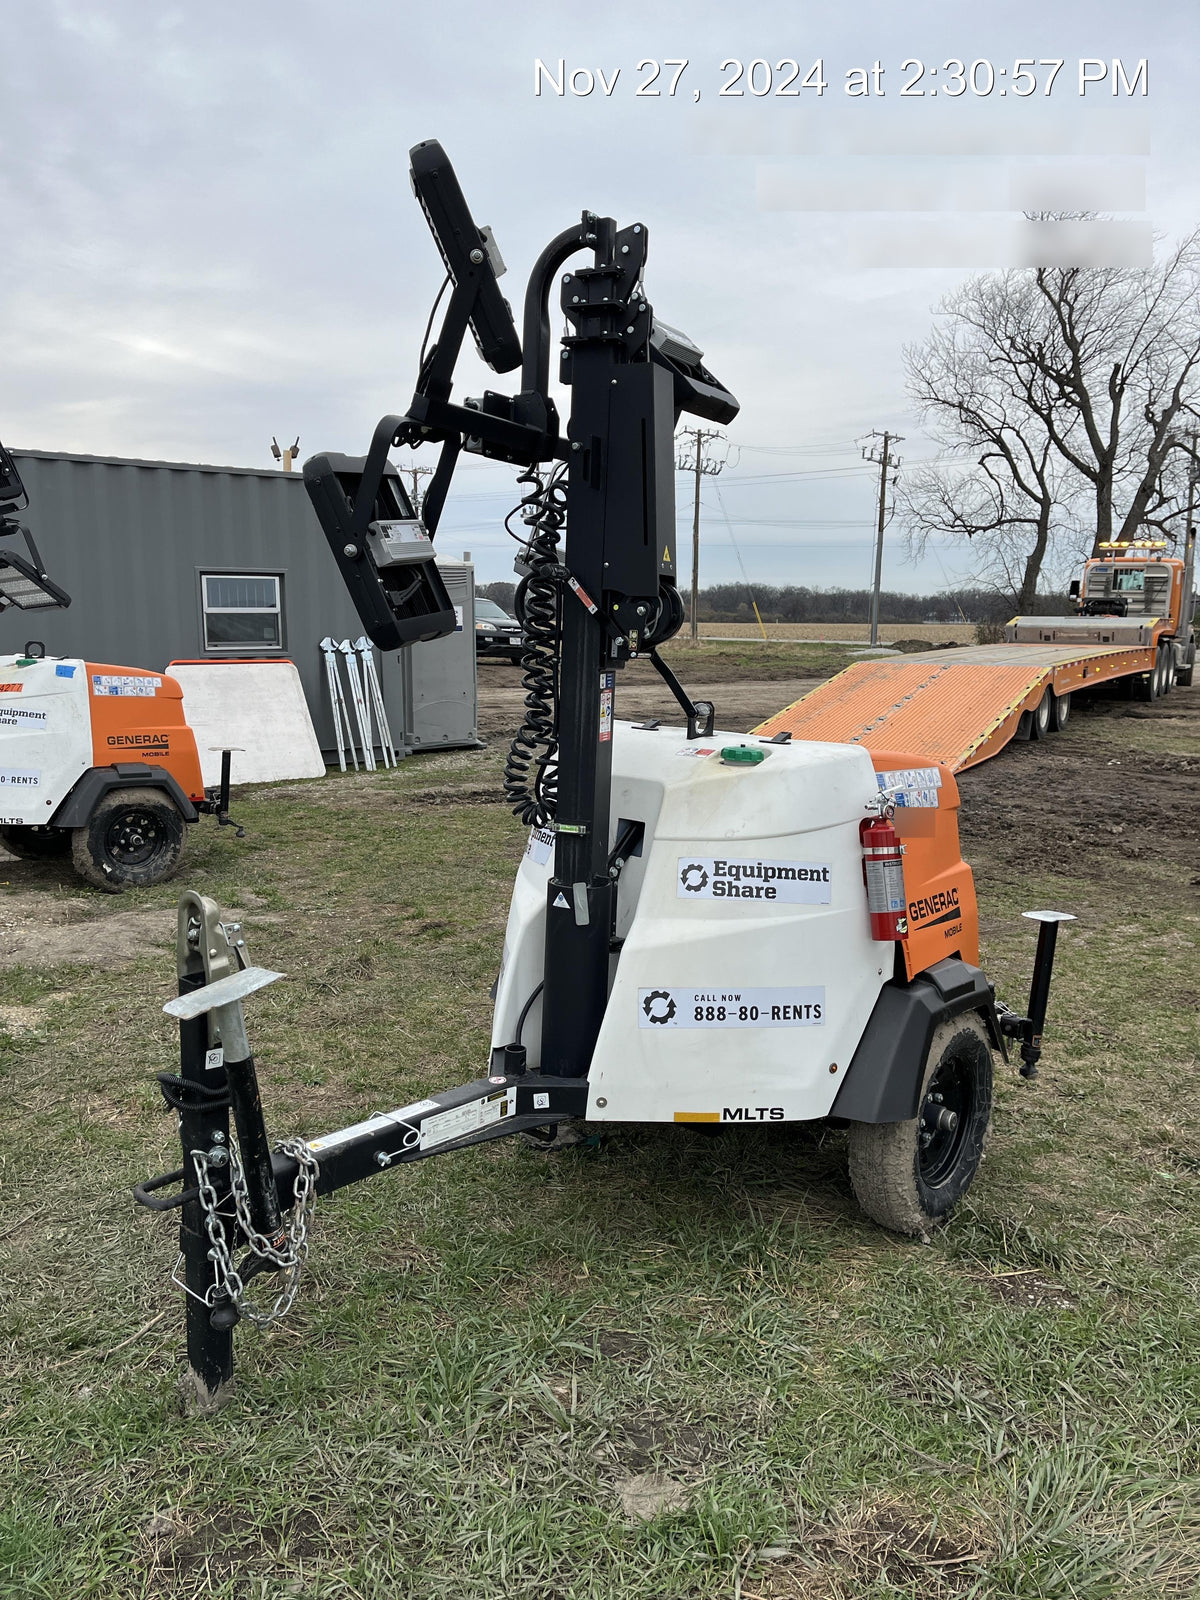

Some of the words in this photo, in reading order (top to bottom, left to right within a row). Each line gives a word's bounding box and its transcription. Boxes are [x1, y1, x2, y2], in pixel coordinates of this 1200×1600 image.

[106, 734, 169, 746] GENERAC
[712, 860, 830, 883] Equipment
[712, 880, 777, 899] Share
[908, 887, 960, 922] GENERAC
[943, 923, 963, 939] MOBILE
[694, 994, 717, 1002] CALL
[721, 994, 742, 1002] NOW
[693, 1004, 822, 1021] 888-80-RENTS
[722, 1107, 785, 1121] MLTS
